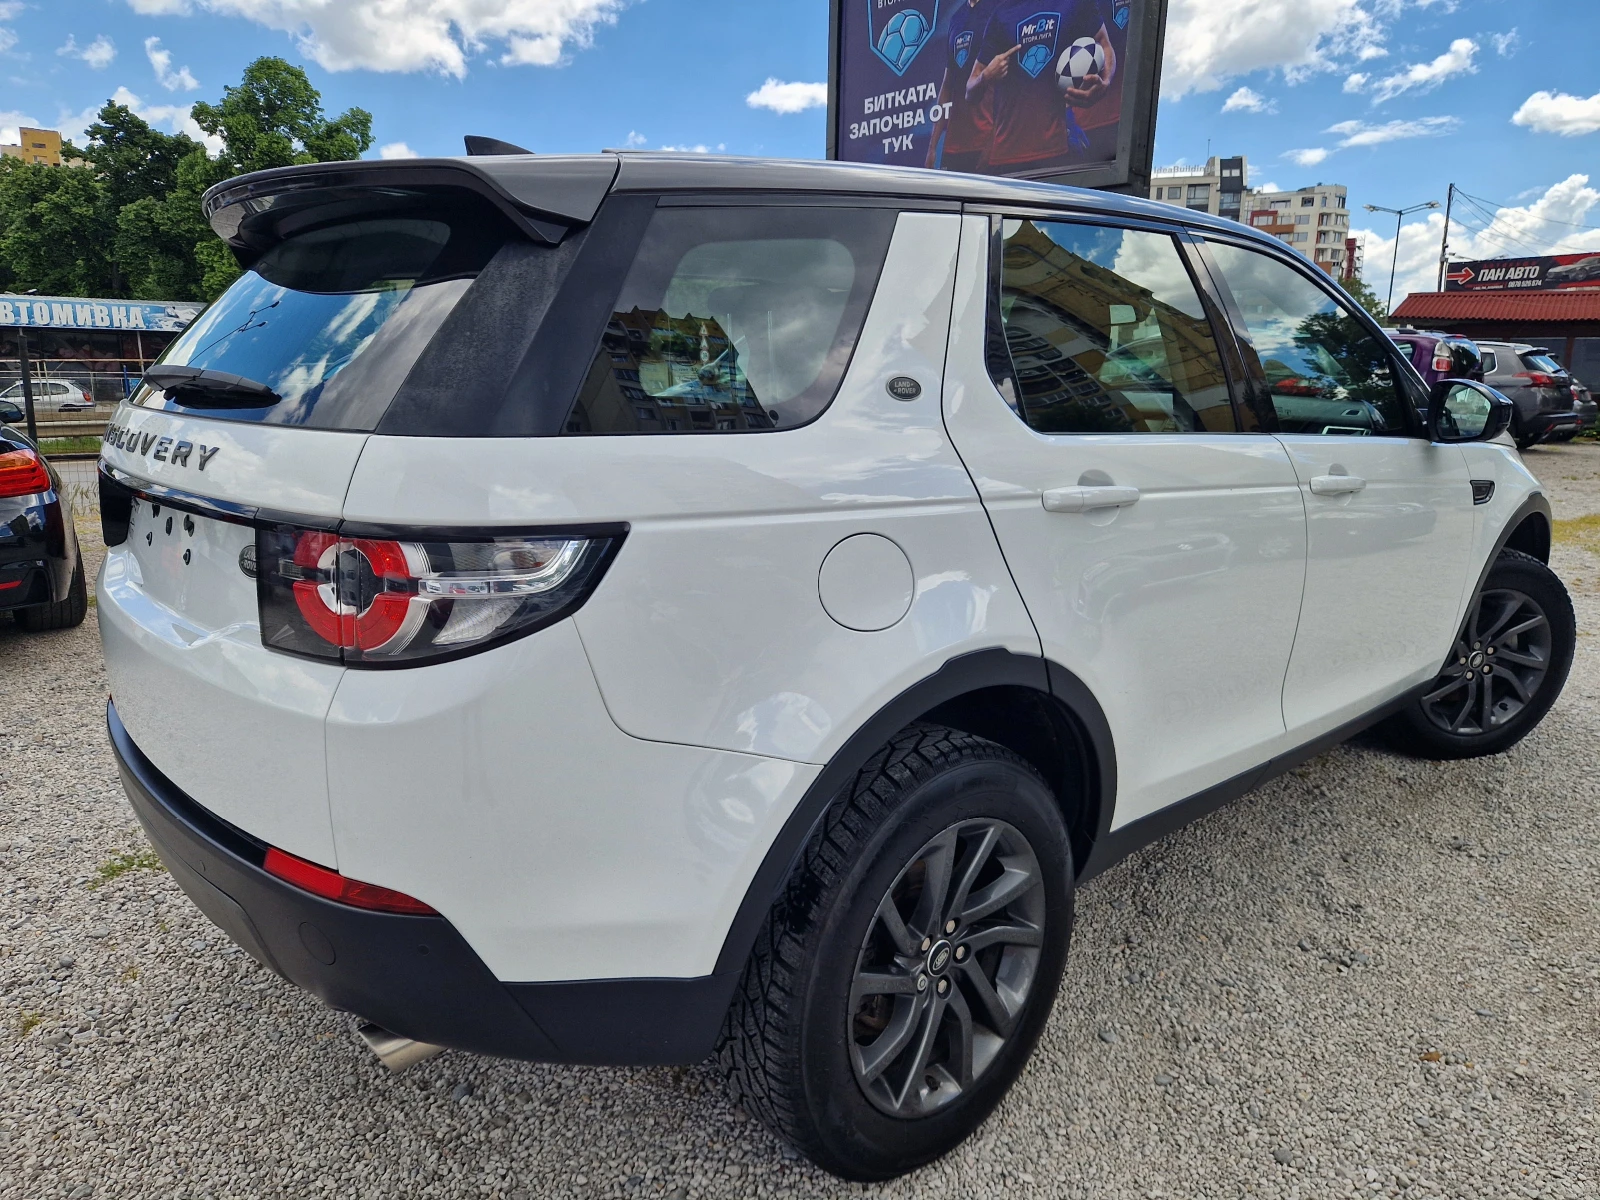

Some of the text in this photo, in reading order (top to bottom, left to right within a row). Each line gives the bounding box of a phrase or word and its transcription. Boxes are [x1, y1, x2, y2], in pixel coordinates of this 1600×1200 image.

[1021, 19, 1055, 37] MrBit
[864, 82, 937, 114] БИТКАТА
[849, 102, 953, 139] ЗАПОЧВА ОТ
[882, 134, 914, 154] ТУК
[1478, 266, 1540, 281] ПАН АВТО
[242, 549, 256, 561] LAN
